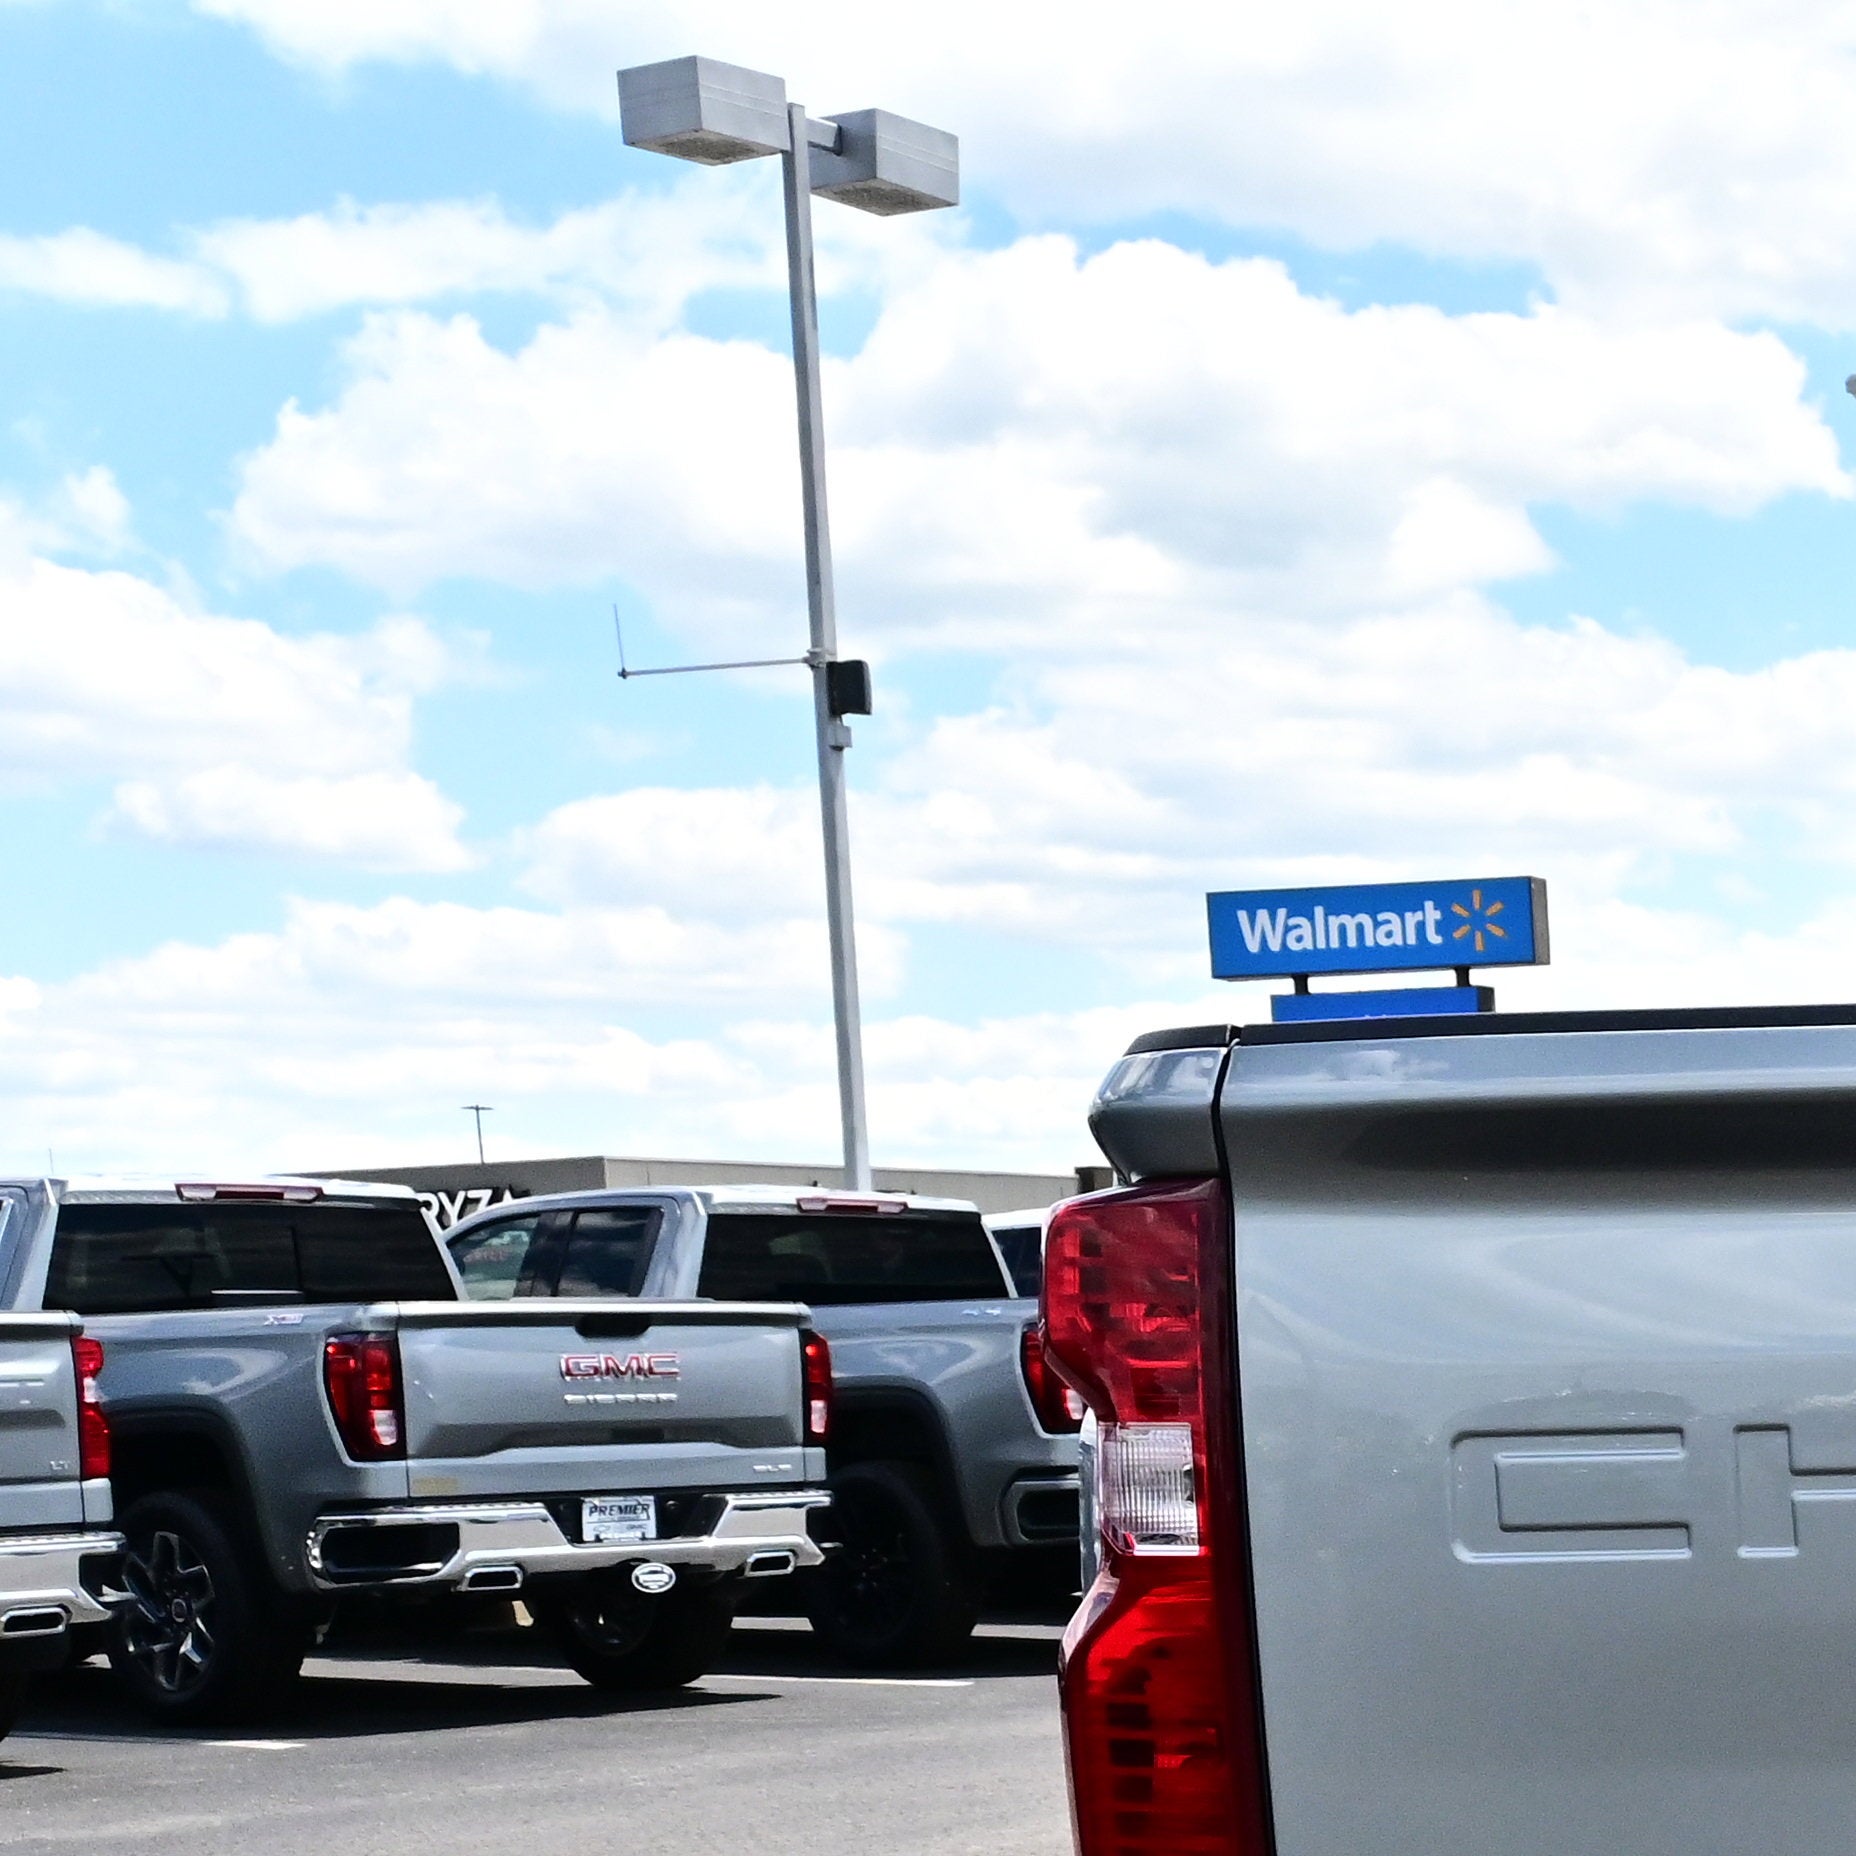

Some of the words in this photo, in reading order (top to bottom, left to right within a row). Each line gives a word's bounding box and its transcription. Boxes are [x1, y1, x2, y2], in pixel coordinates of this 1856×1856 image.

[1236, 900, 1443, 953] Walmart
[561, 1352, 681, 1381] GMC
[588, 1503, 650, 1520] PREMIER
